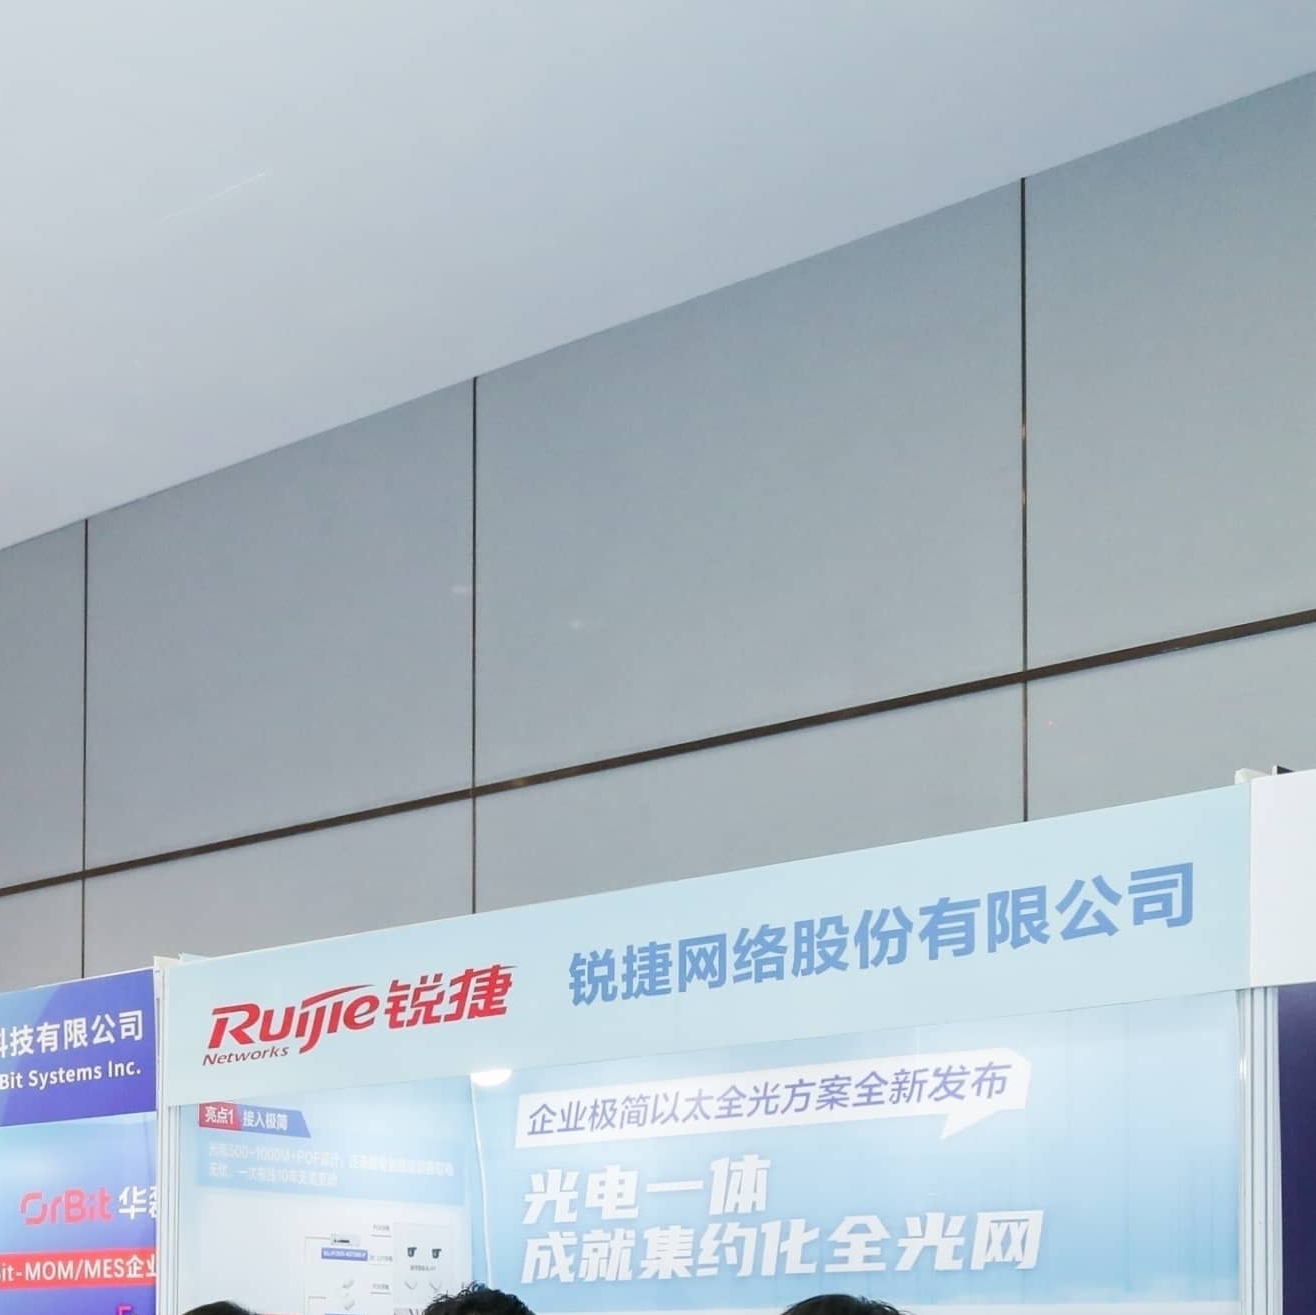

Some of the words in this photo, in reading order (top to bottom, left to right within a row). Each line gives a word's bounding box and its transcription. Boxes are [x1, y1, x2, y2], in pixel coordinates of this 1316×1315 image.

[568, 861, 1195, 1007] 锐捷网络股份有限公司
[384, 963, 517, 1030] 锐捷
[28, 1065, 103, 1091] Systems
[108, 1059, 142, 1078] Inc.
[202, 1046, 289, 1067] Networks
[526, 1060, 1012, 1137] 企业极简以太全光方案全新发布
[523, 1153, 772, 1225] 光电一体
[520, 1209, 1045, 1284] 成就集约化全光网
